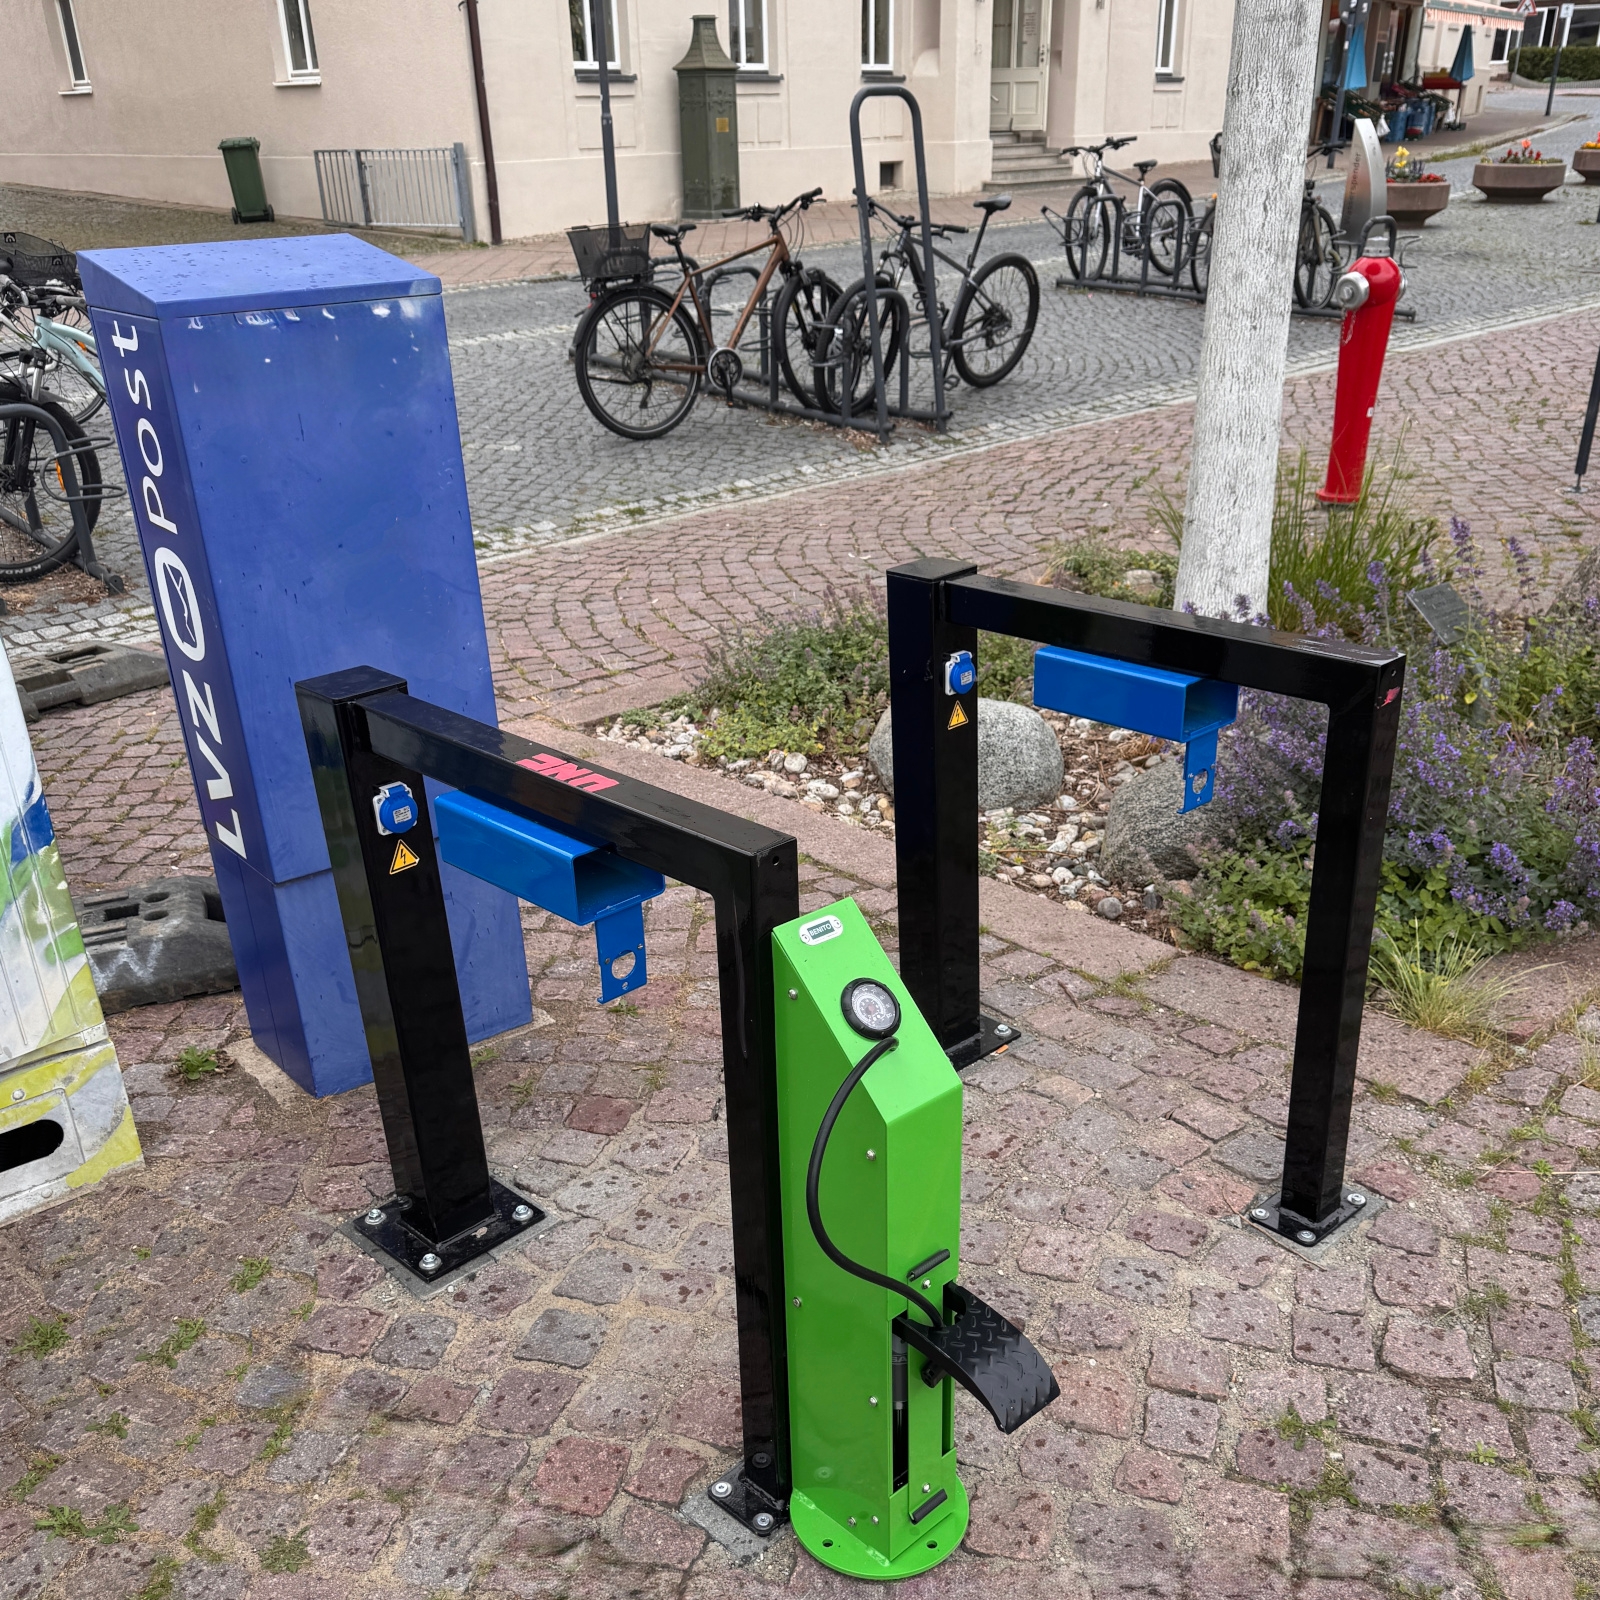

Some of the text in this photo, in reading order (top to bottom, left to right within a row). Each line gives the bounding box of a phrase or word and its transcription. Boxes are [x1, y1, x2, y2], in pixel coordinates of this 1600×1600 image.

[112, 320, 247, 859] LVZ Post
[809, 923, 832, 936] BENITO
